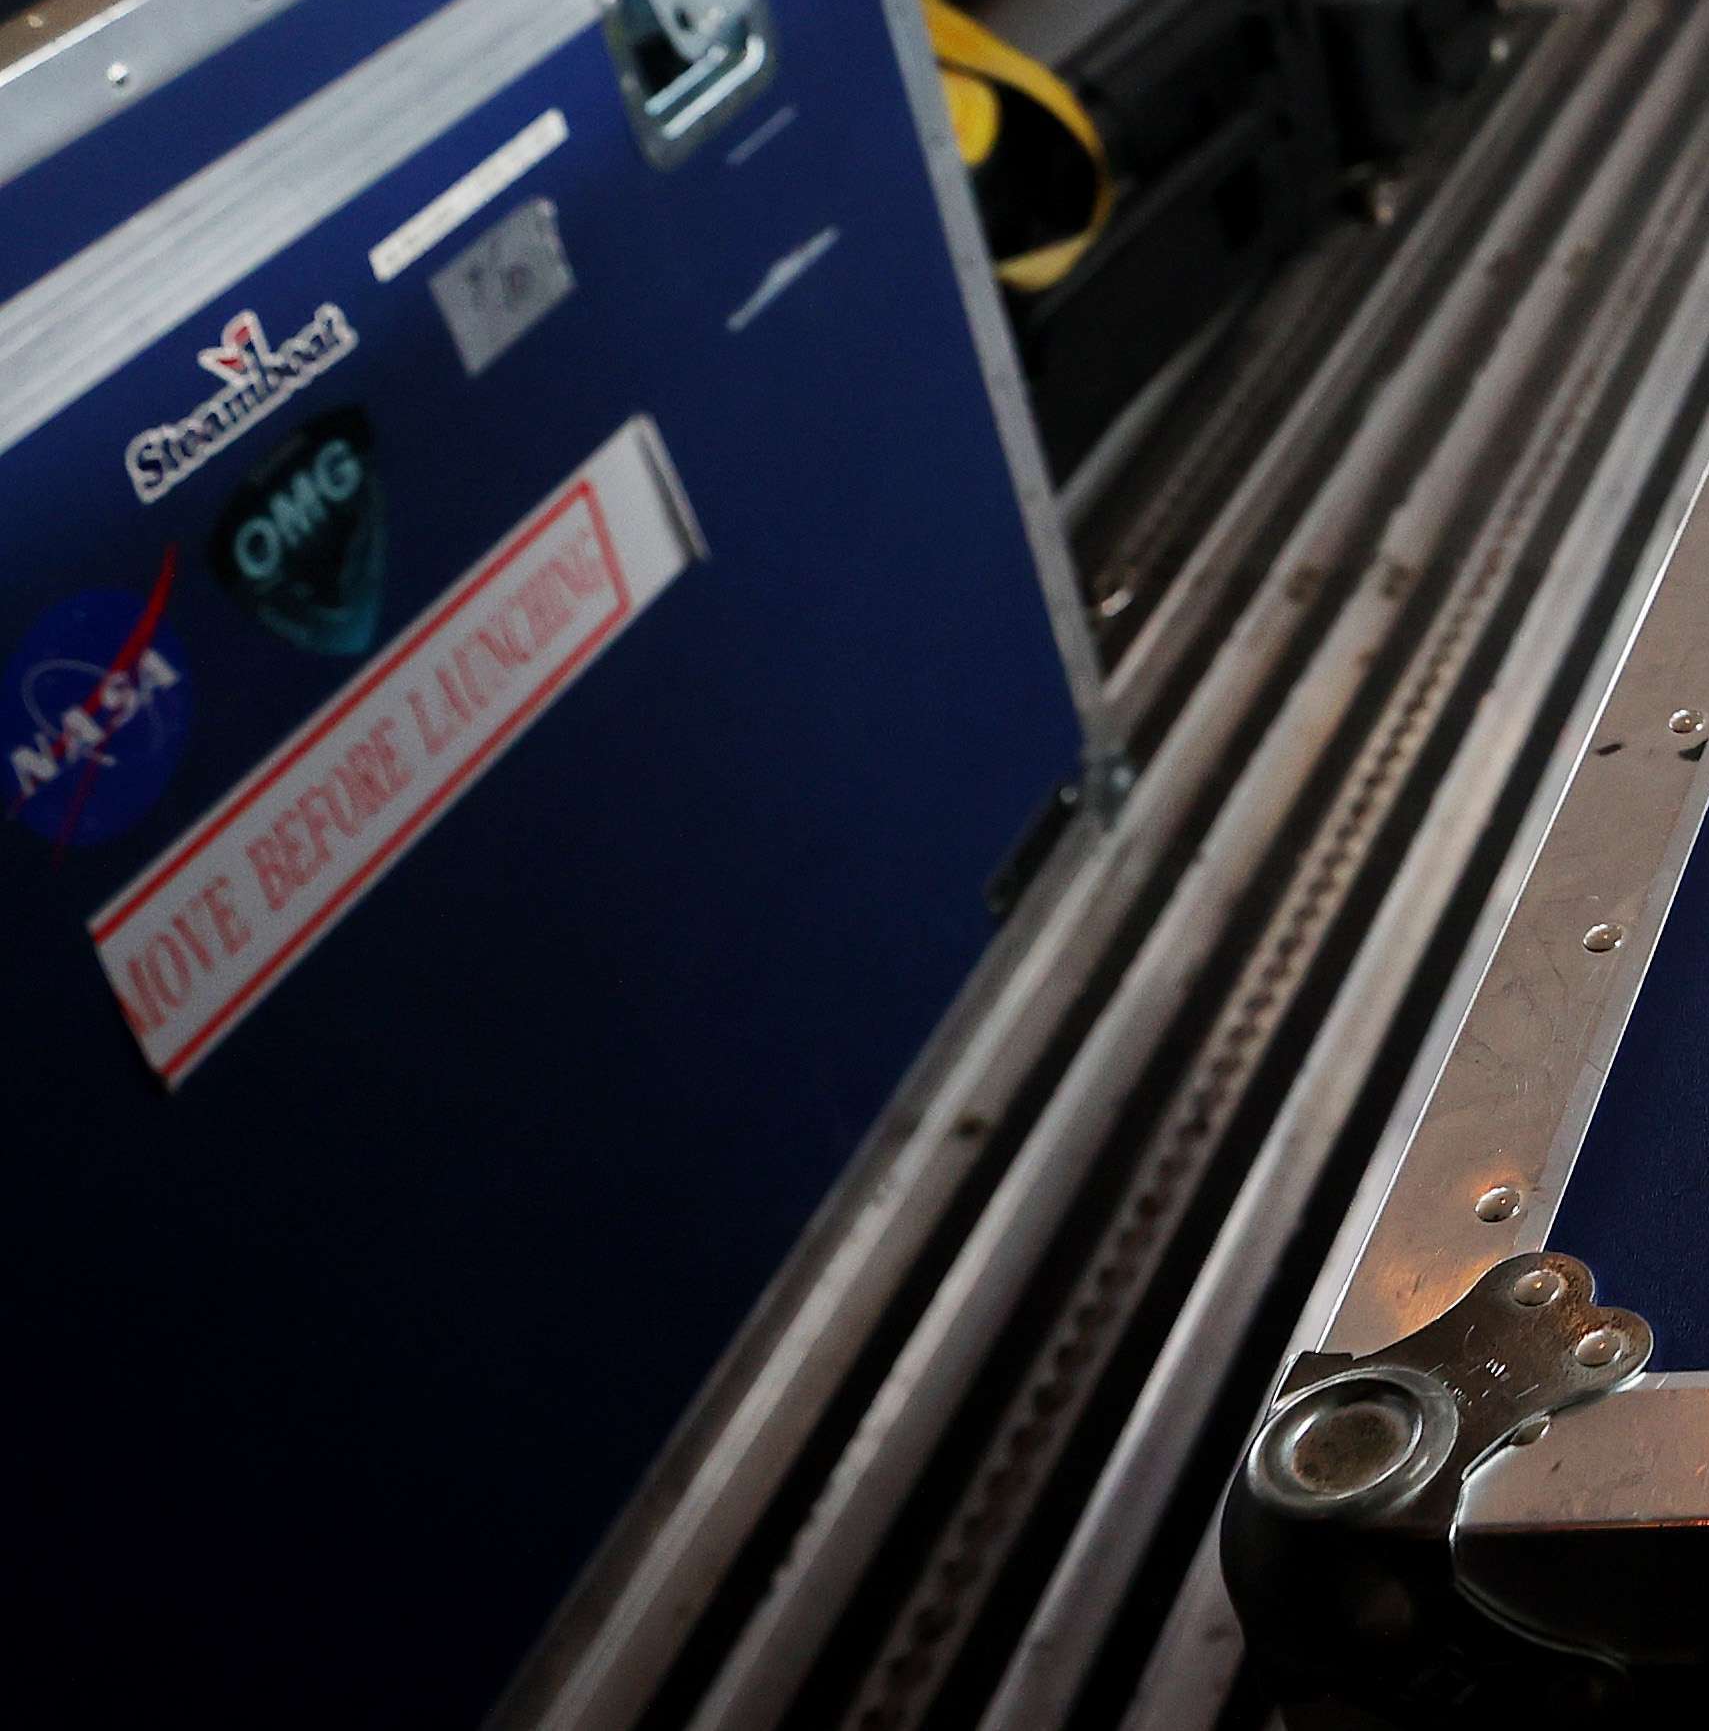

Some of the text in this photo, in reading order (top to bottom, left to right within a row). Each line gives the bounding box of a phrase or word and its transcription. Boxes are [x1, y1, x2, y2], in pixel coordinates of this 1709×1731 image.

[234, 438, 363, 580] OMG
[10, 647, 181, 797] NASA
[243, 716, 413, 912] BEFORE
[405, 525, 607, 757] LAUNCHING
